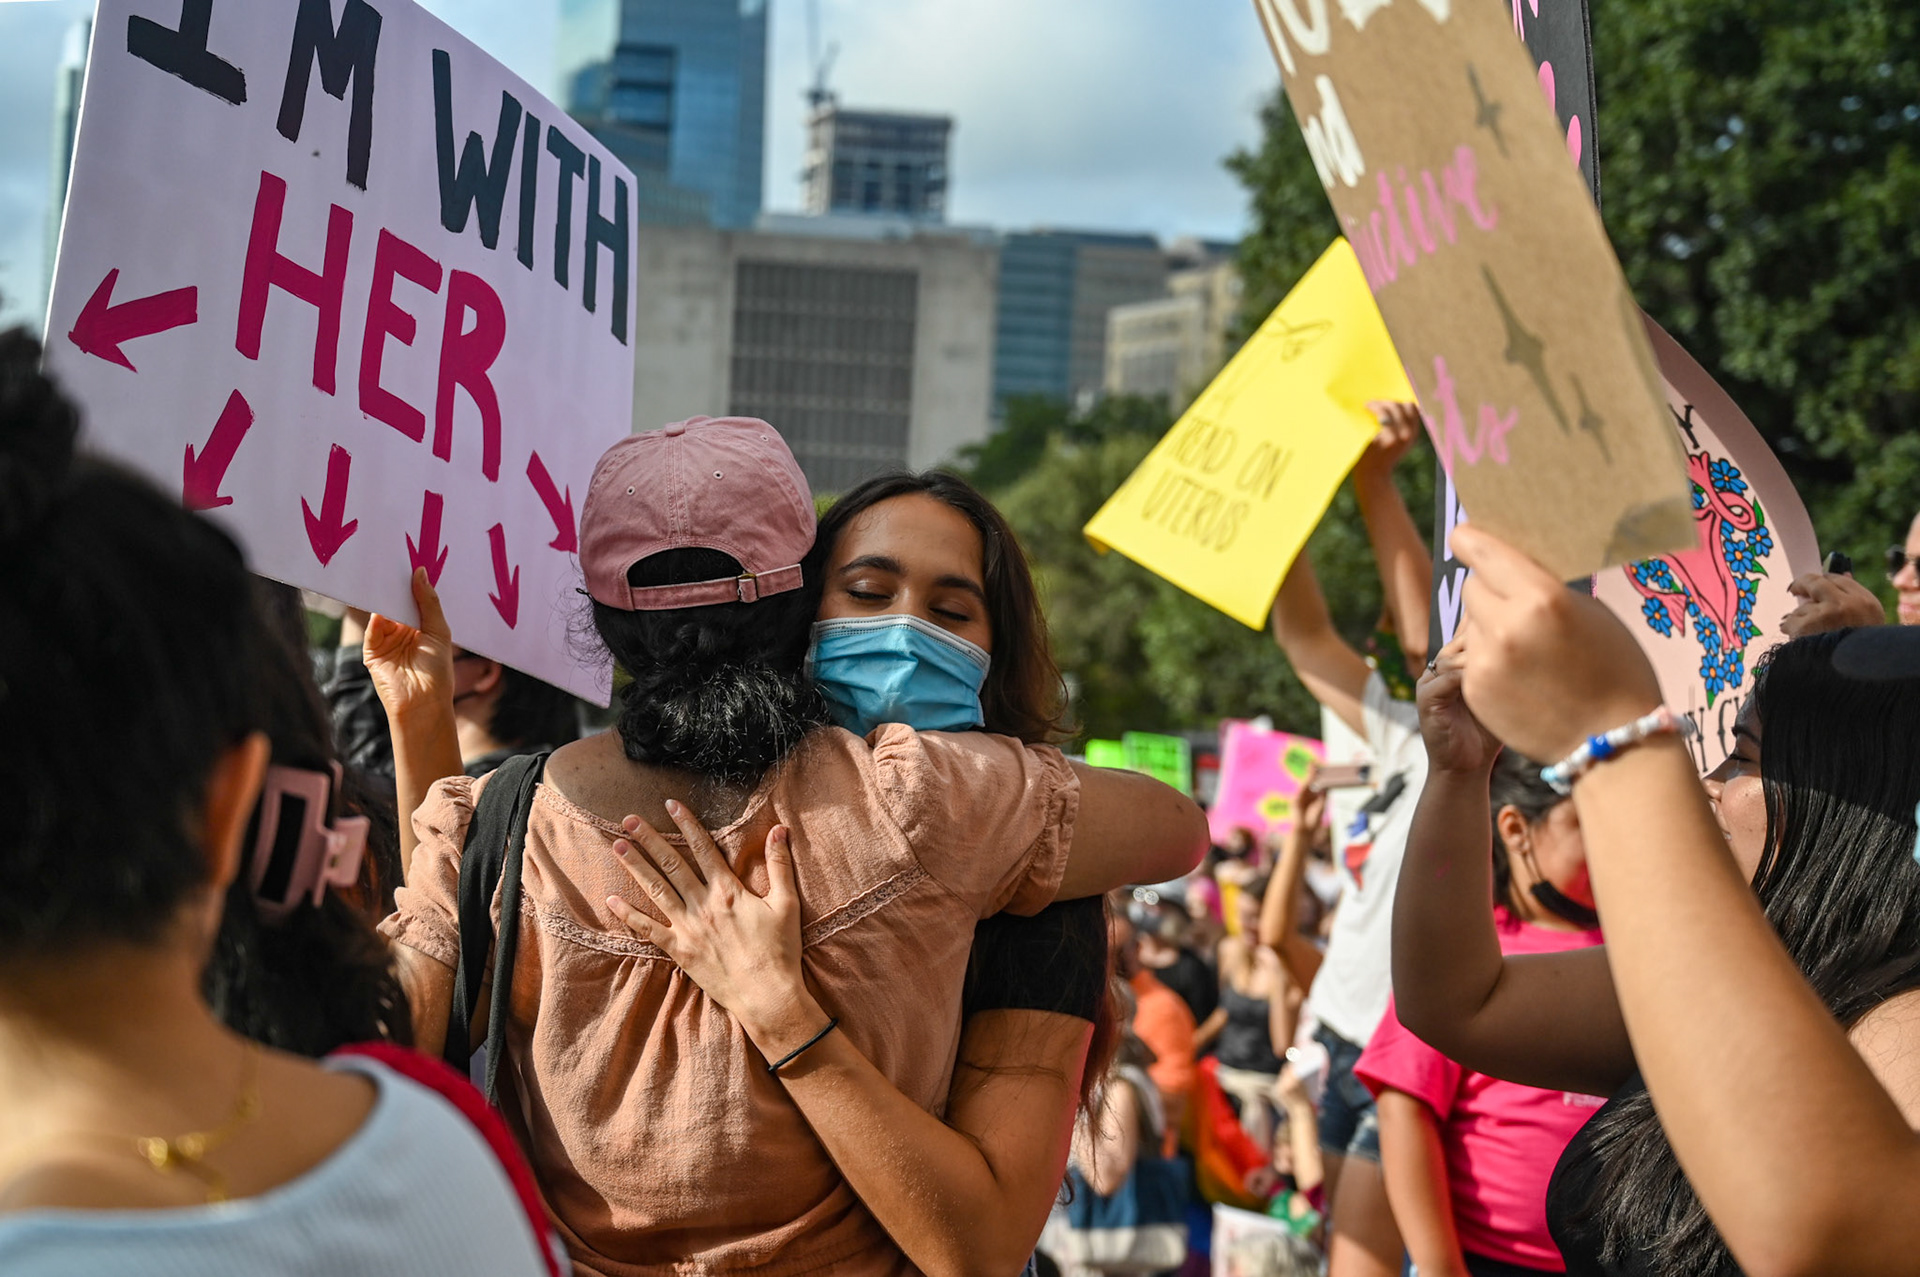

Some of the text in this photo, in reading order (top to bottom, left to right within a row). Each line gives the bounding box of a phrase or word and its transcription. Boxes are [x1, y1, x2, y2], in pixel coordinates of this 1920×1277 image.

[432, 48, 629, 346] WITH
[235, 170, 507, 484] HER
[1141, 468, 1251, 554] UTERUS
[1234, 440, 1295, 501] ON
